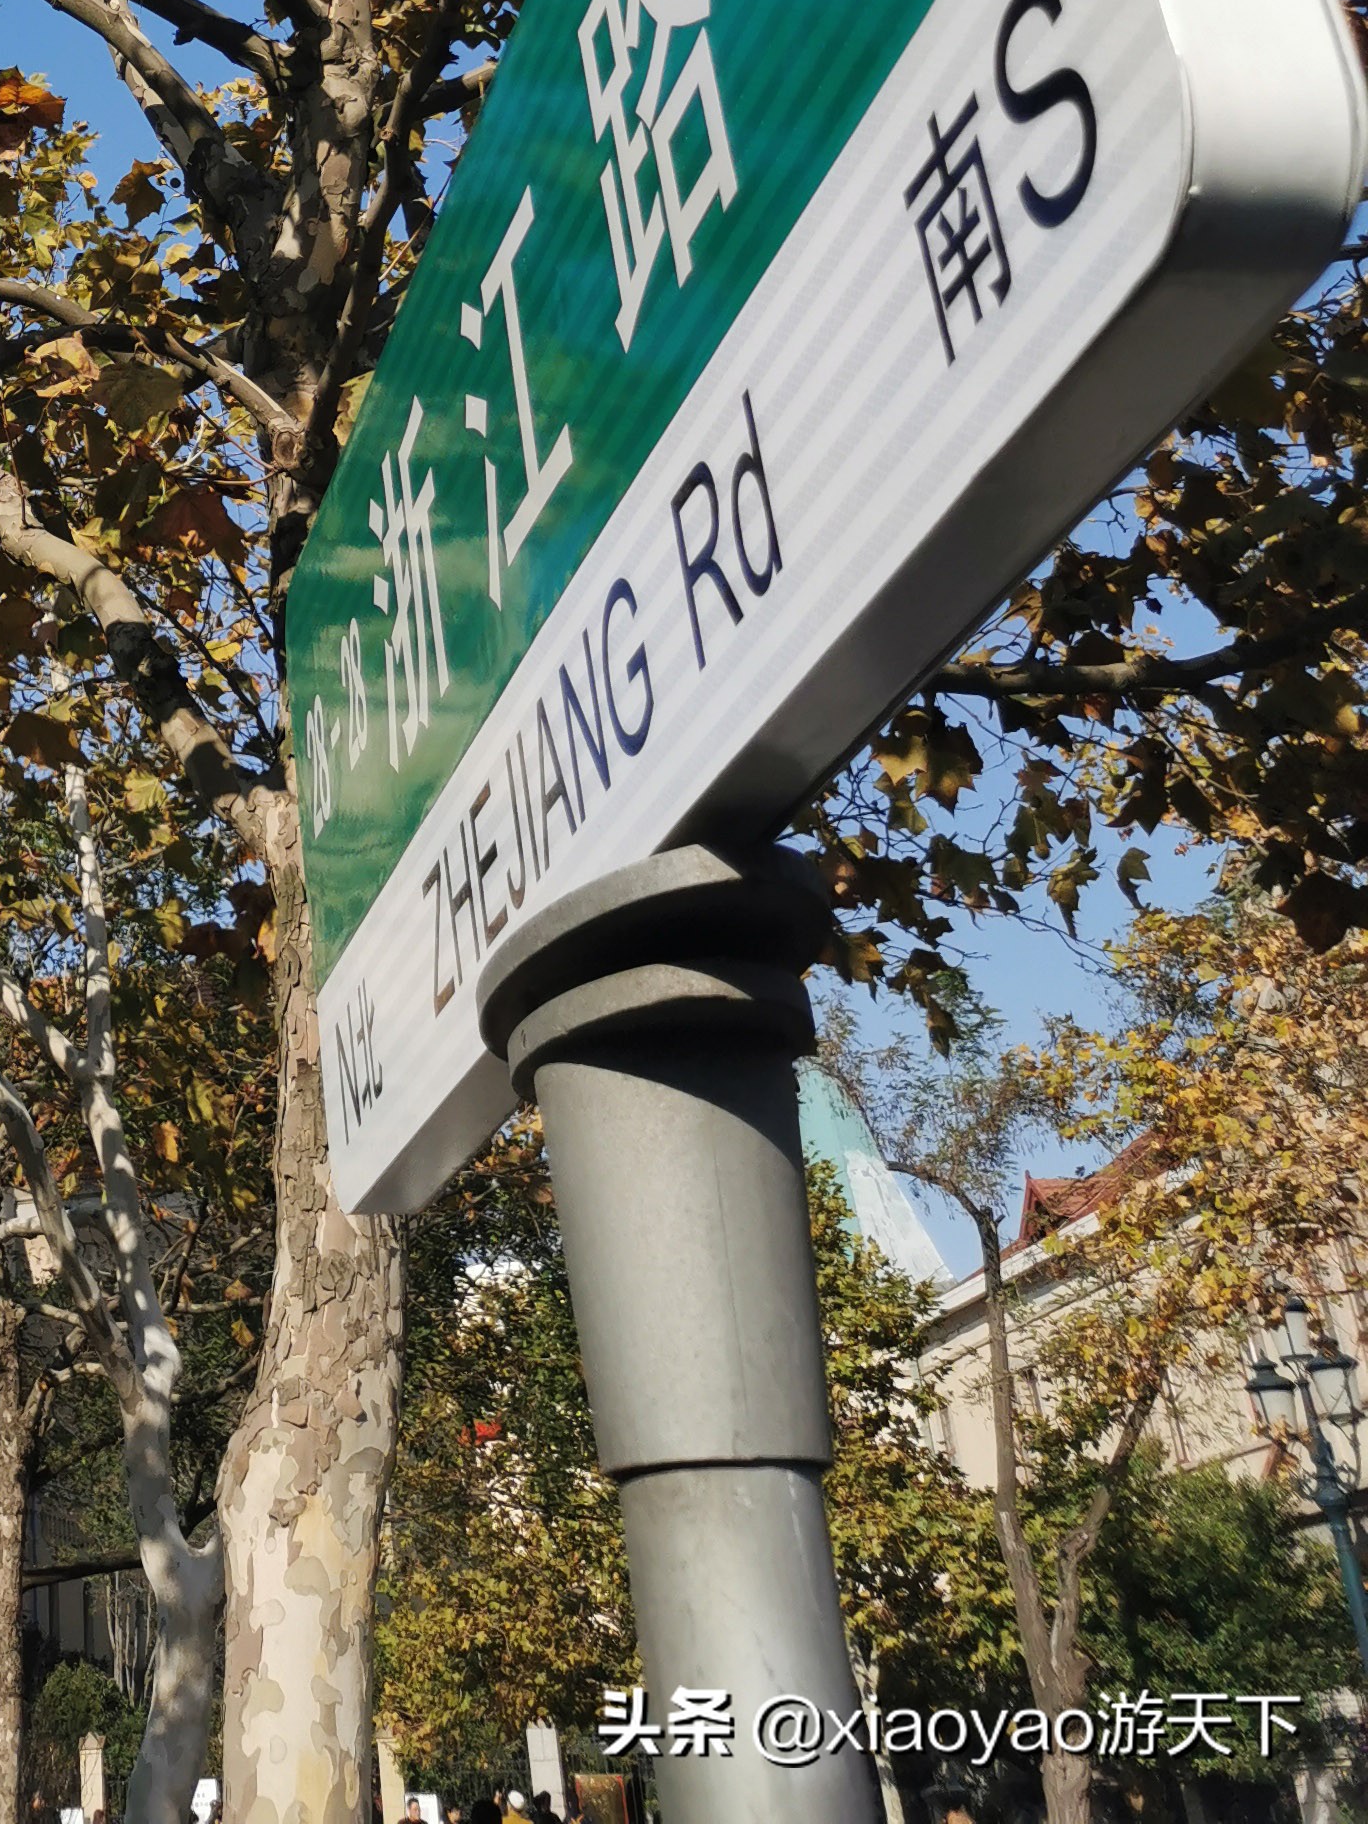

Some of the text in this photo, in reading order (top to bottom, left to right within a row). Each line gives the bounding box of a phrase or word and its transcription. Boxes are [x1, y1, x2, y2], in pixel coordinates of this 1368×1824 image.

[306, 617, 368, 840] 28-28
[421, 577, 655, 1018] ZHEJIANG
[670, 388, 783, 672] Rd
